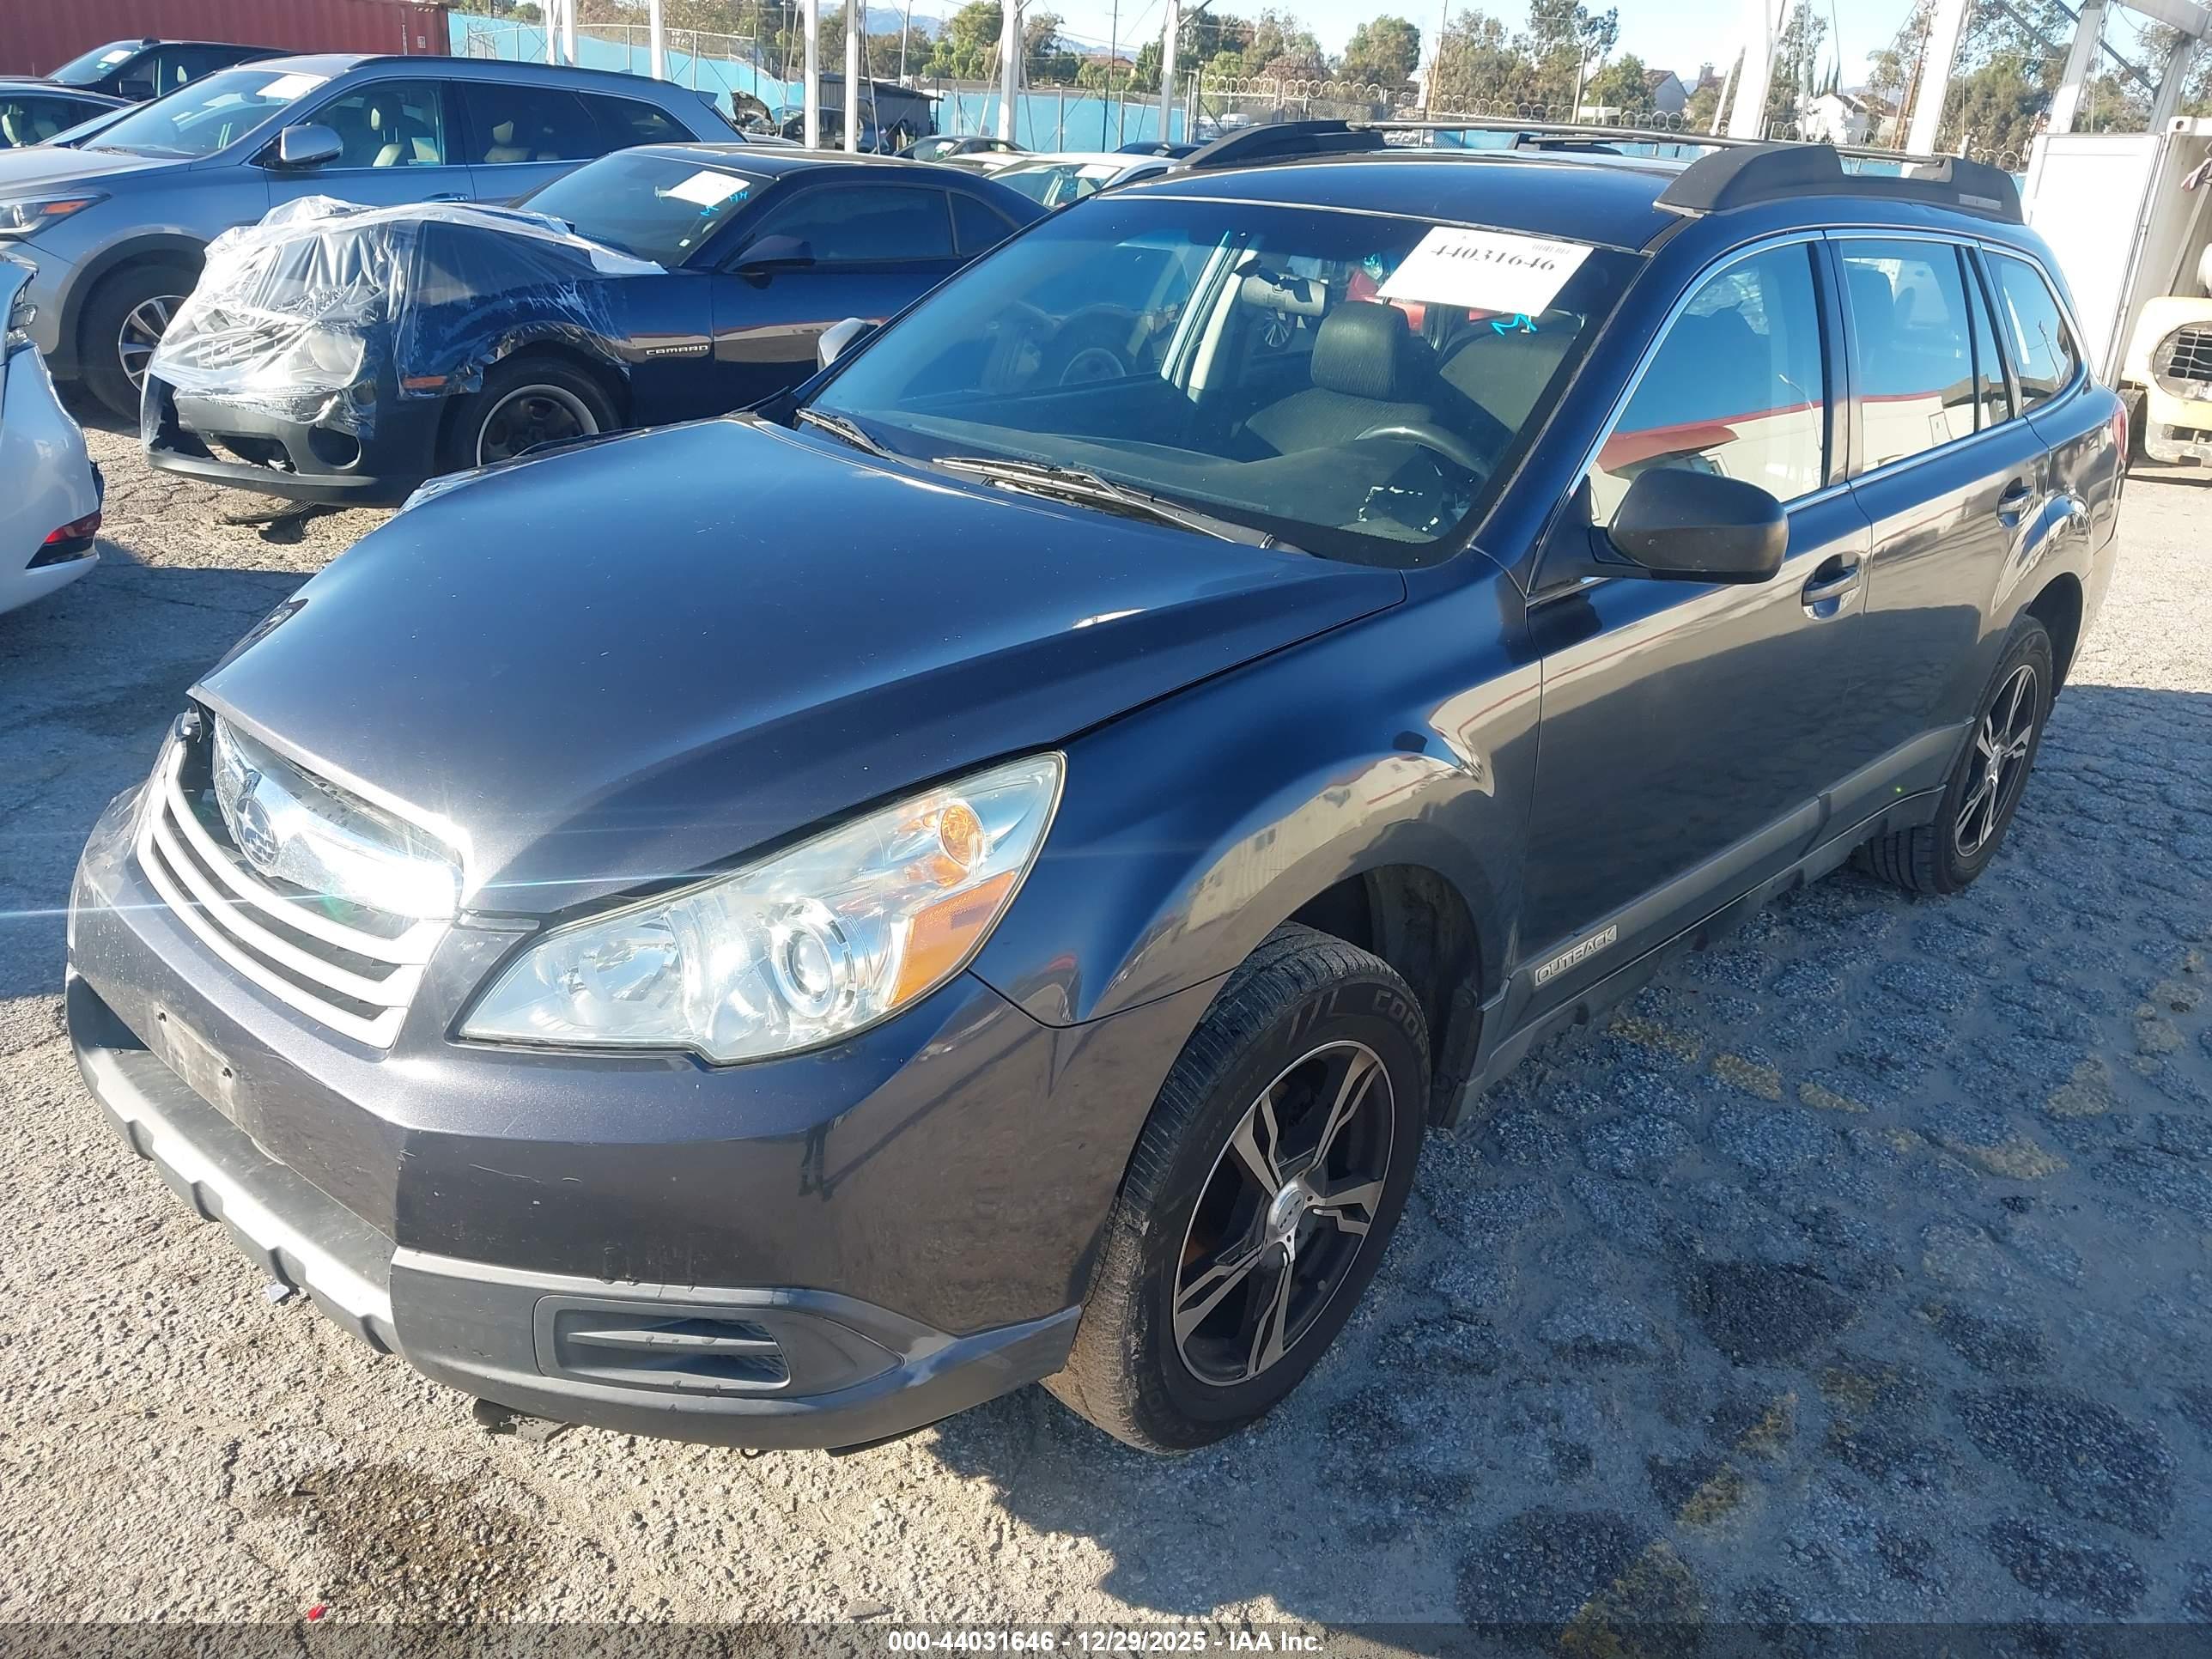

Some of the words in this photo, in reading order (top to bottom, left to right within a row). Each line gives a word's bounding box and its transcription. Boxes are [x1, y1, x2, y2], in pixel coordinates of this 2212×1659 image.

[1430, 244, 1555, 270] 44031646
[646, 345, 708, 356] CAMARO
[1536, 926, 1616, 984] OUTBACK
